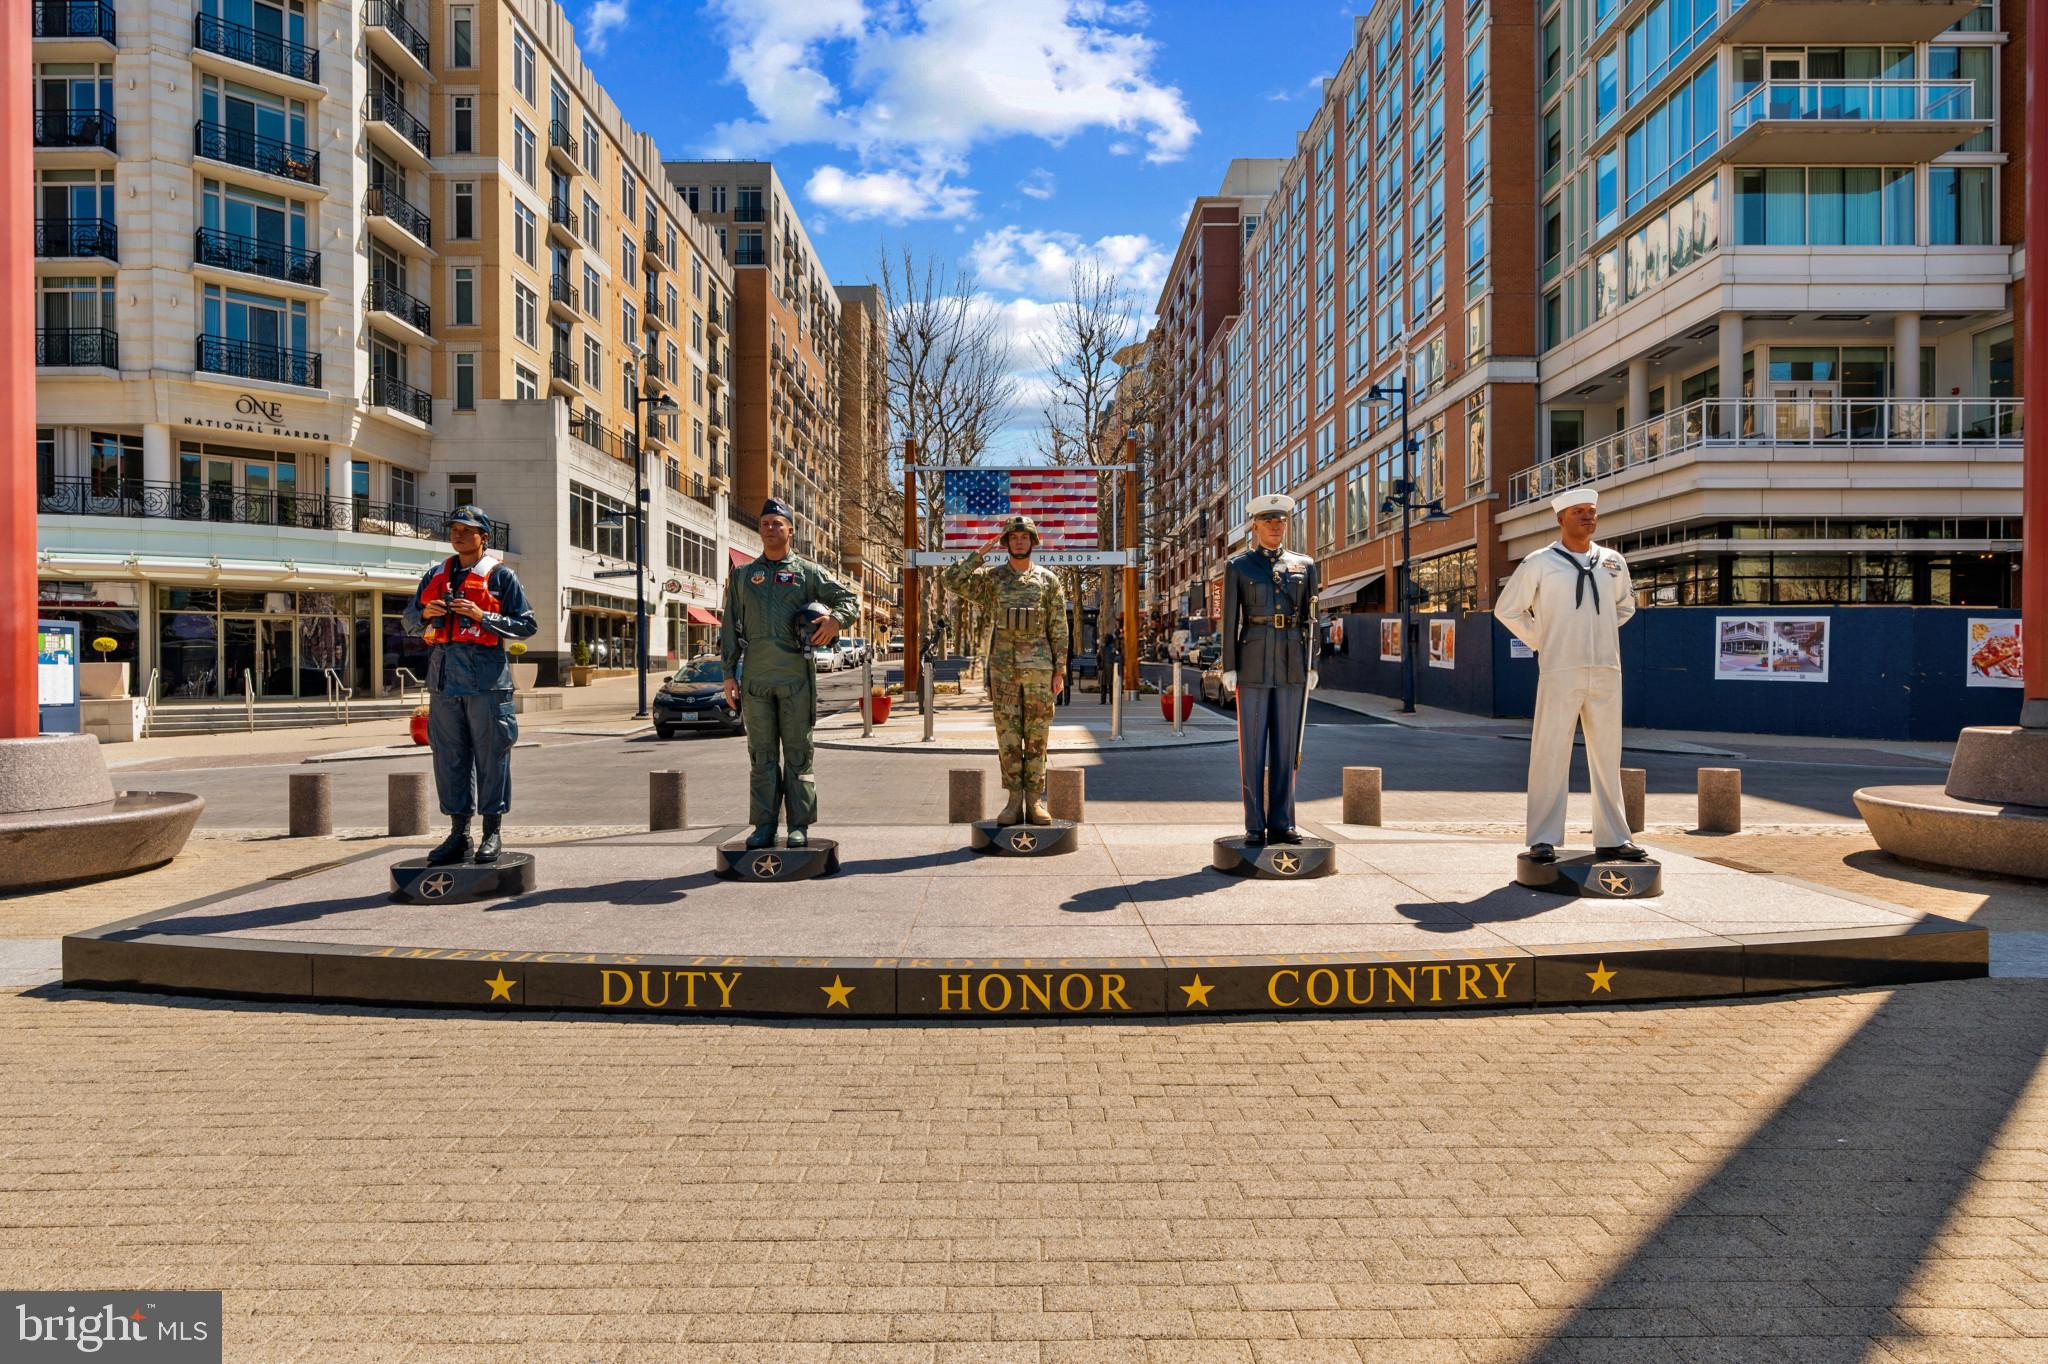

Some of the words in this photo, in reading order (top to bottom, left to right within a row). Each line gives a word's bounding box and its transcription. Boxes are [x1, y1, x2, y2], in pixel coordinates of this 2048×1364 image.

[235, 393, 284, 423] ONE
[184, 416, 263, 433] NATIONAL
[273, 427, 329, 441] HARBOR
[1039, 555, 1093, 563] HARBOR
[600, 969, 743, 1008] DUTY
[938, 973, 1133, 1012] HONOR
[1267, 962, 1518, 1007] COUNTRY
